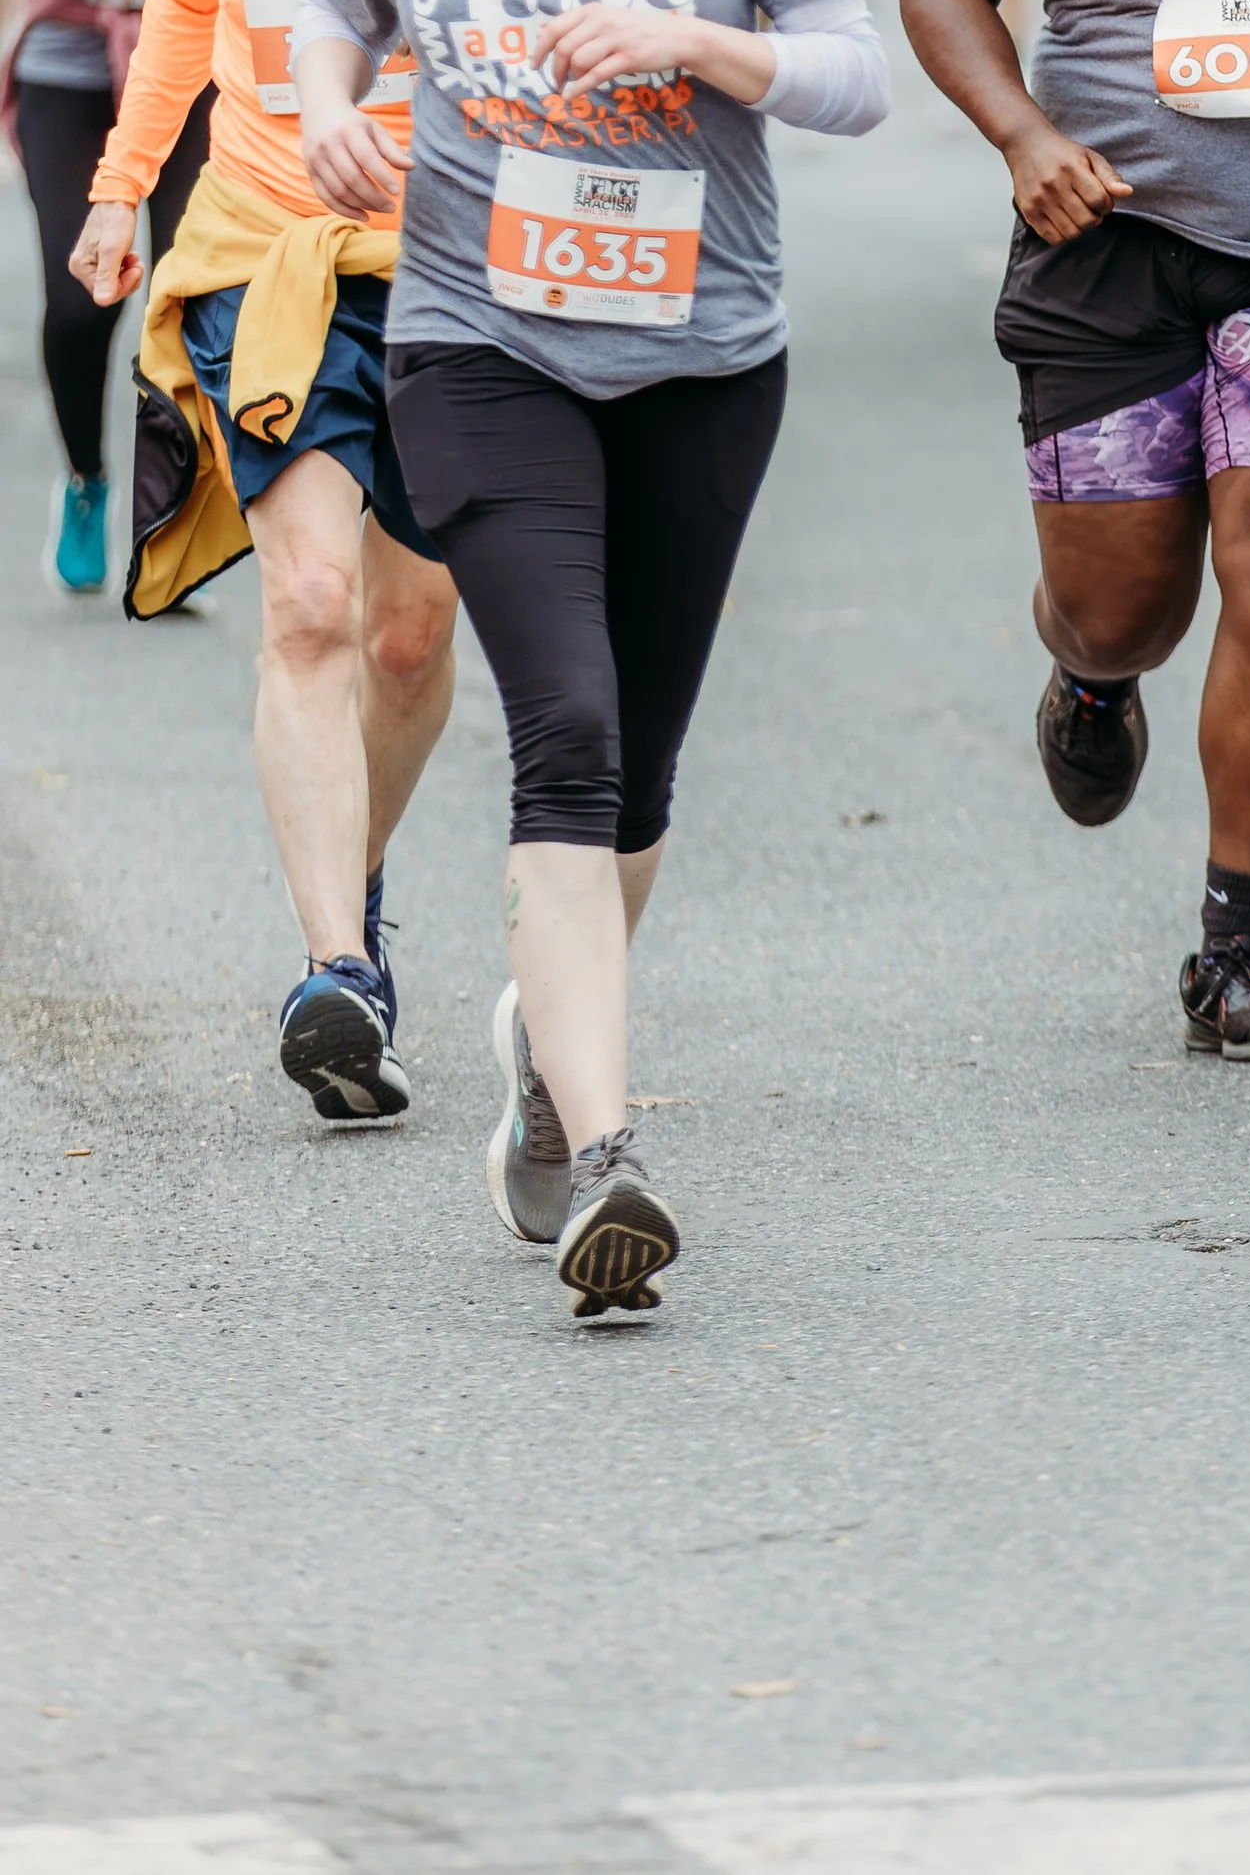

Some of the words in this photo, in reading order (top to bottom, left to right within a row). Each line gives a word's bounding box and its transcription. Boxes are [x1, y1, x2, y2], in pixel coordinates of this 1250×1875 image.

[461, 97, 540, 125] PRIL
[573, 173, 585, 206] ywca
[583, 198, 637, 213] RACISM
[522, 218, 667, 285] 1635
